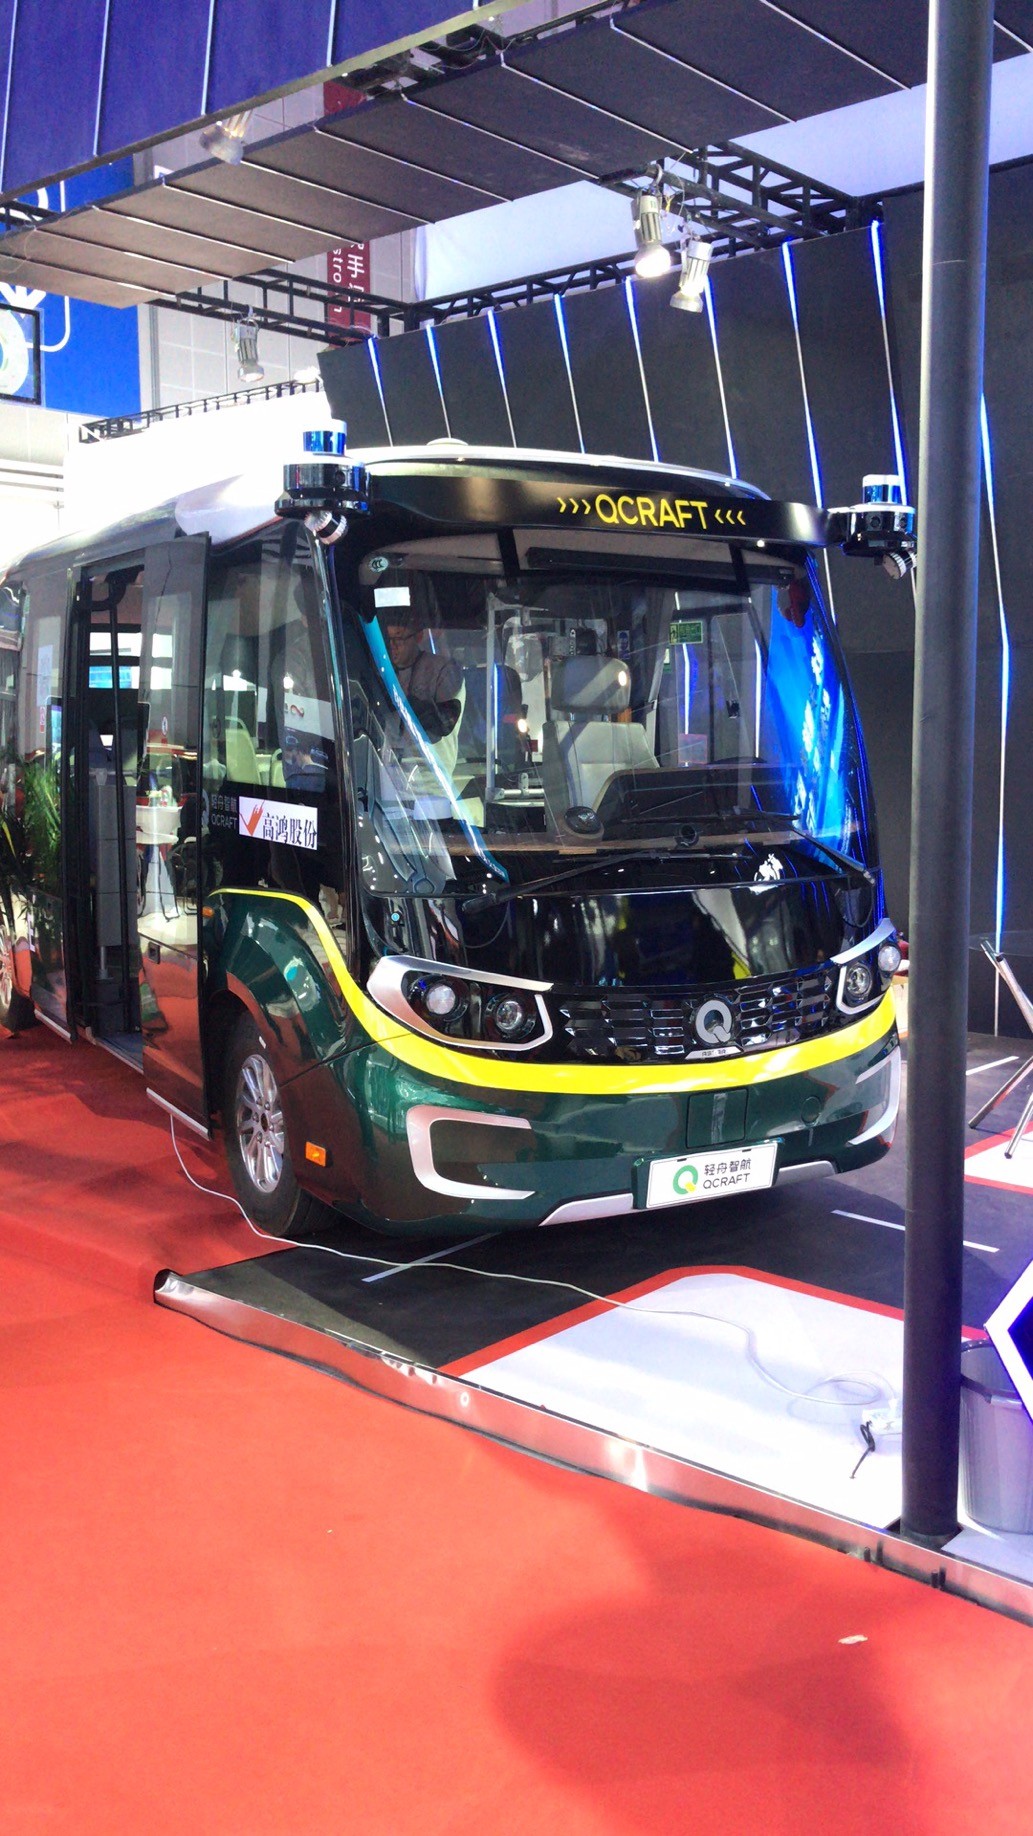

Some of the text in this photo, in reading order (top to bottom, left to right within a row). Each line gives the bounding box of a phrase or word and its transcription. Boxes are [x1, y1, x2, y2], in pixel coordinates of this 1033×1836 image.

[595, 493, 708, 530] QCRAFT
[262, 811, 318, 849] 高鸿股份
[702, 1172, 750, 1189] QCRAFT
[704, 1158, 751, 1176] 轻舟智航
